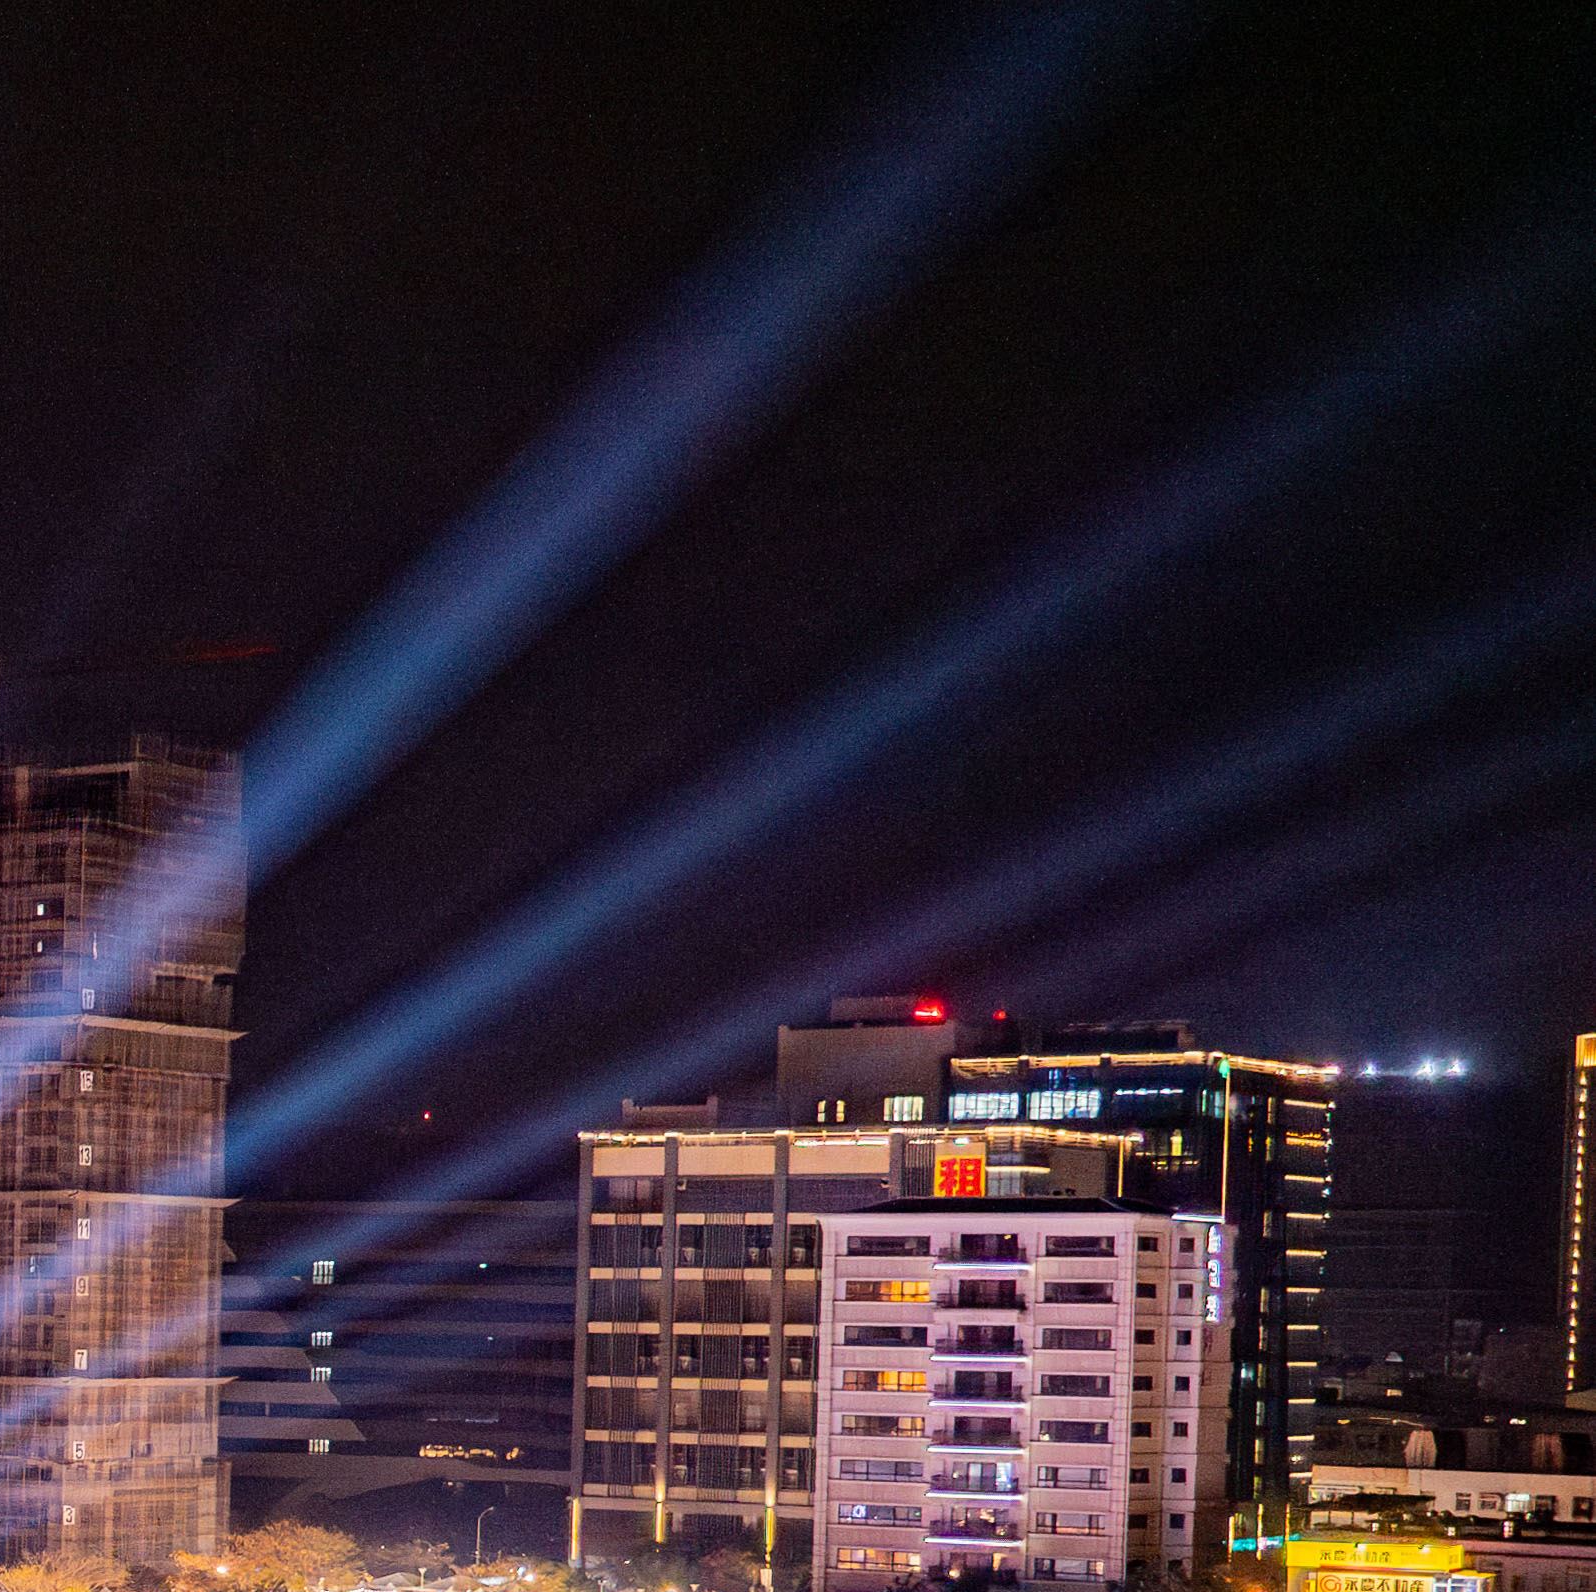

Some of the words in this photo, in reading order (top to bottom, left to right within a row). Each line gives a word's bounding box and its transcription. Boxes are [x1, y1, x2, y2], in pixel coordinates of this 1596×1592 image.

[80, 1147, 91, 1164] 13
[939, 1158, 982, 1197] 租
[78, 1220, 90, 1238] 11
